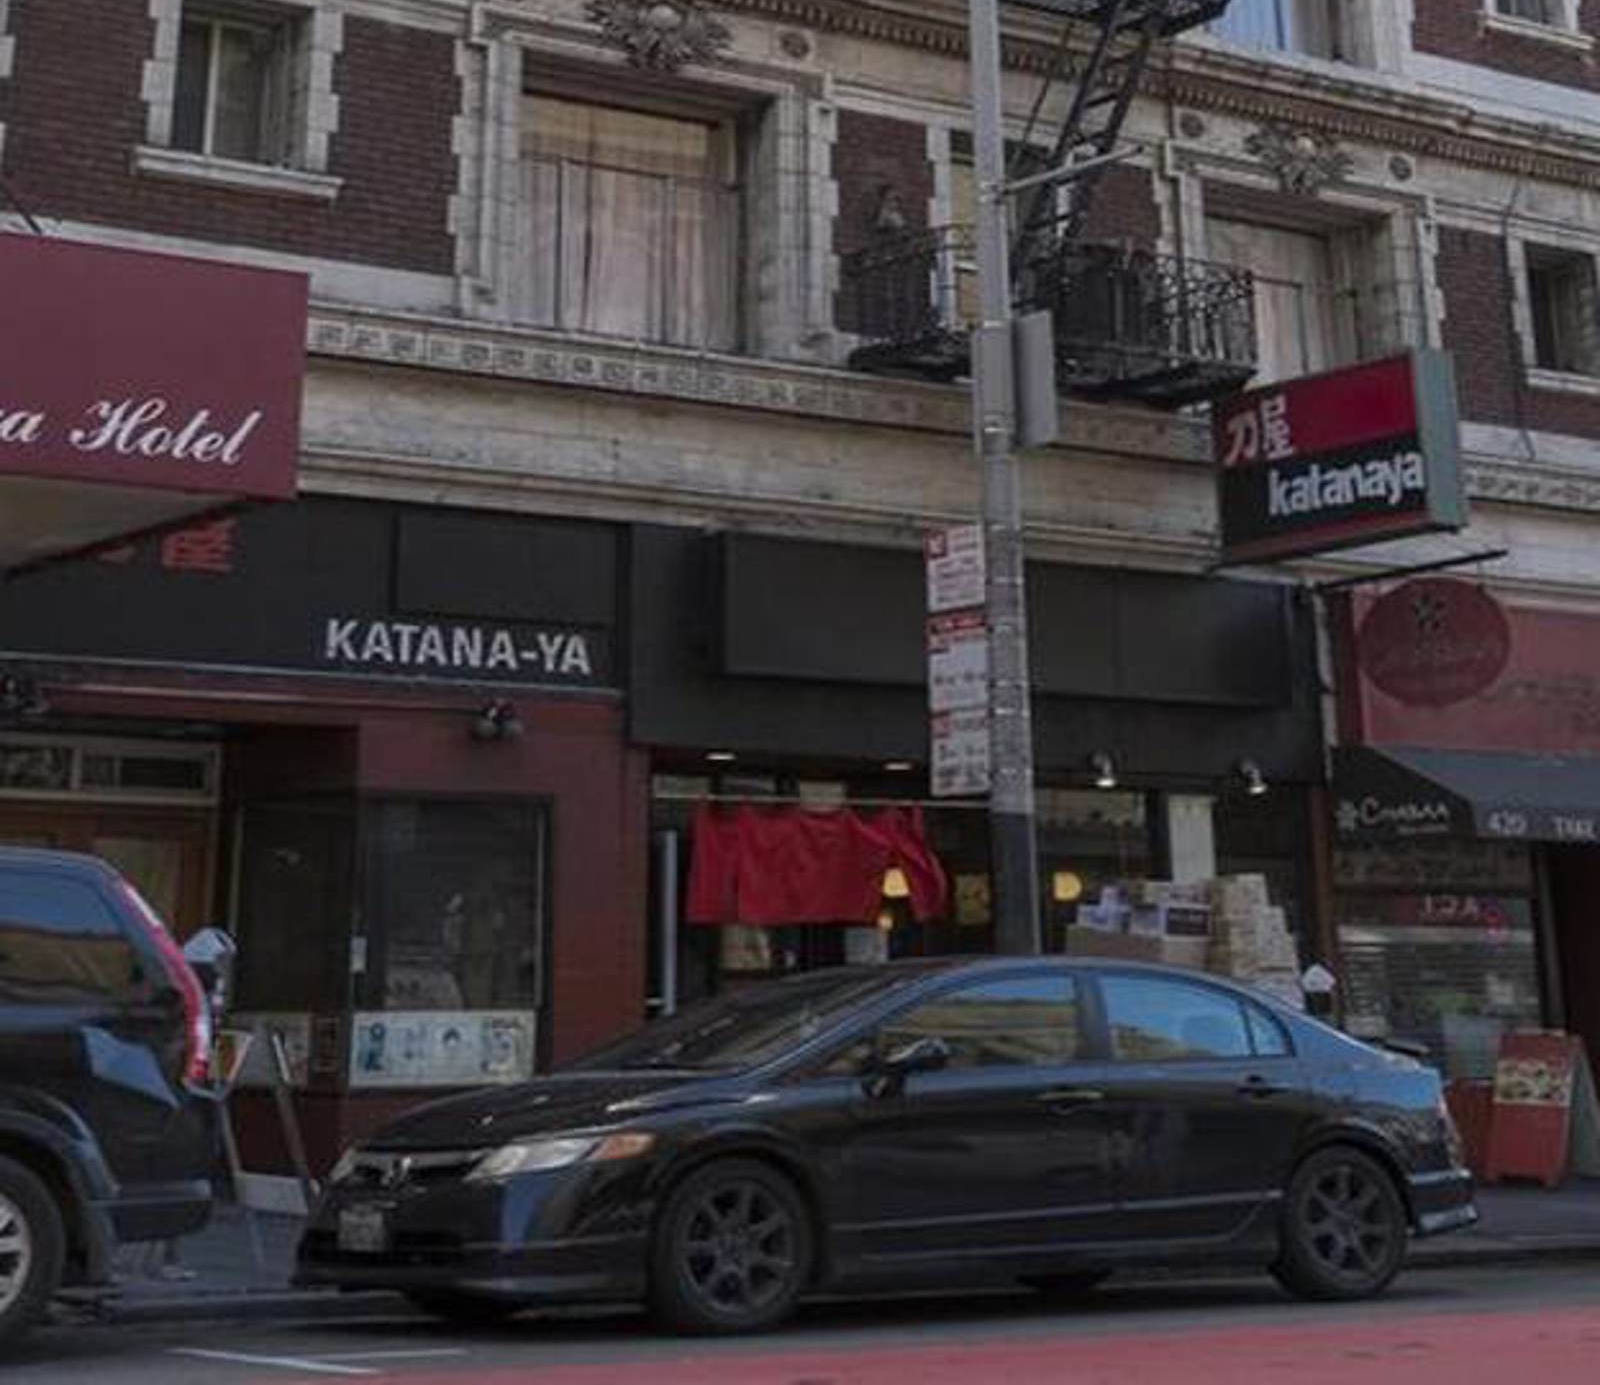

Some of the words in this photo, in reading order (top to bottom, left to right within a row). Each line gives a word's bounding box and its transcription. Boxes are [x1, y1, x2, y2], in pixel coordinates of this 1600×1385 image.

[69, 397, 262, 465] Hotel
[1267, 451, 1424, 516] katanaya
[326, 618, 591, 675] KATANA-YA
